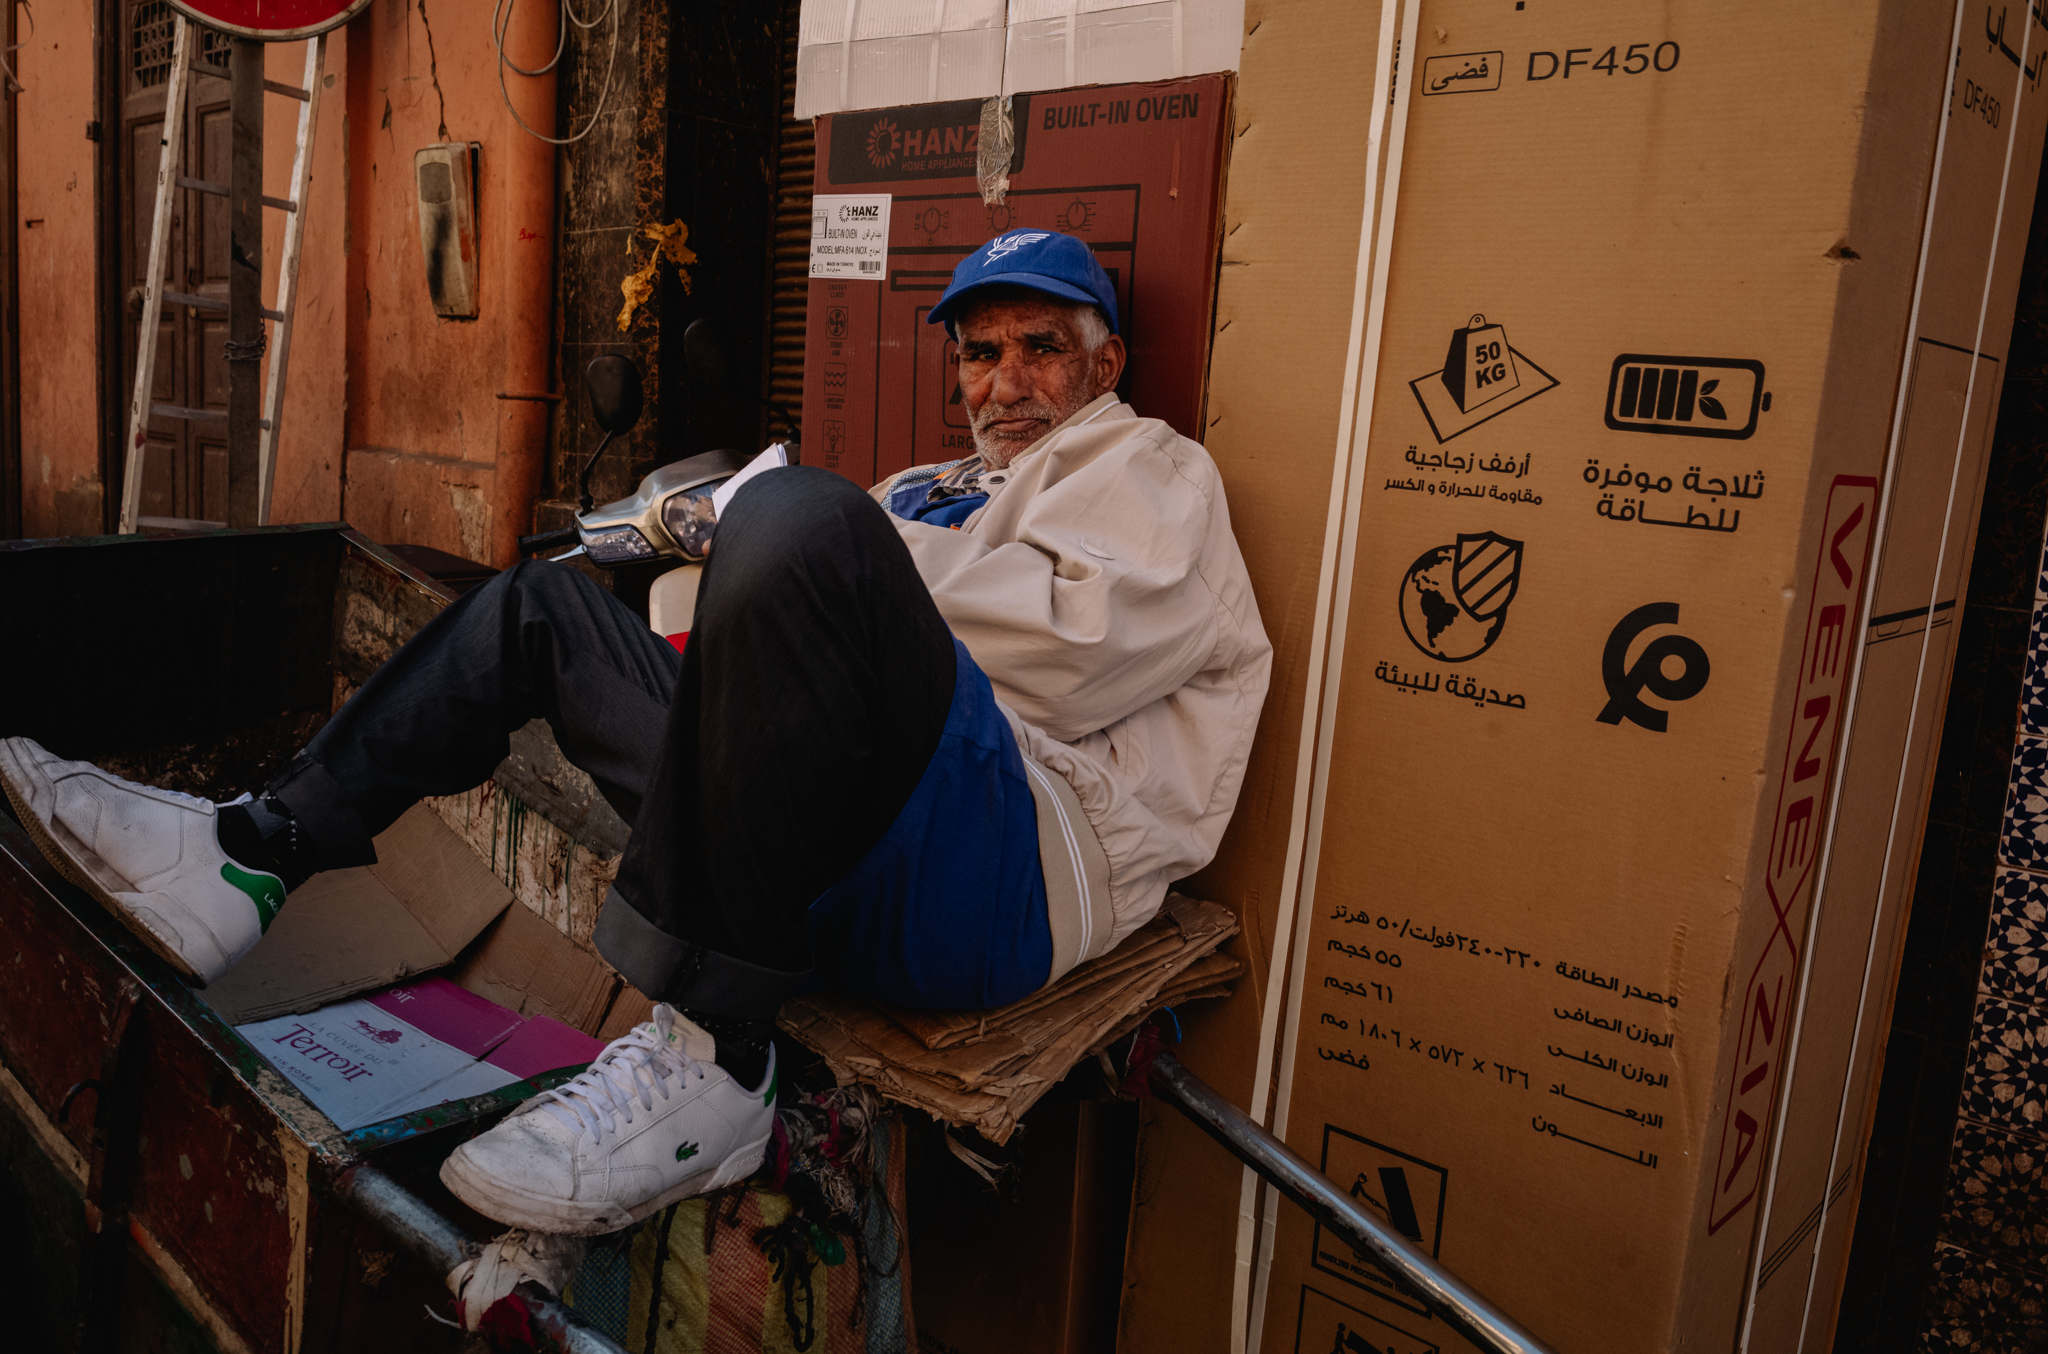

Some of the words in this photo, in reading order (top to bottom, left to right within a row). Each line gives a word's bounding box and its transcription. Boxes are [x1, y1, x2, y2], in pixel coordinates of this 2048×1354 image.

[1526, 40, 1681, 81] DF450
[1043, 100, 1131, 131] BUILT-IN
[1136, 92, 1200, 122] OVEN
[1963, 78, 2001, 129] DF450
[903, 124, 979, 158] HANZ
[901, 159, 926, 172] HOME
[927, 156, 978, 171] APPLIANCES
[852, 206, 879, 216] HANZ
[828, 283, 847, 291] ENERGY
[1475, 340, 1501, 365] 50
[1475, 362, 1506, 390] KG
[942, 433, 976, 450] LARG
[1404, 444, 1475, 475] زجاجية
[1478, 452, 1531, 478] أرفف
[1383, 477, 1425, 492] الكسر
[1582, 458, 1673, 494] موفرة
[1682, 465, 1765, 504] ثلاجة
[1427, 482, 1435, 496] و
[1438, 480, 1487, 498] للحرارة
[1488, 484, 1543, 506] مقاومة
[1374, 660, 1441, 695] للبيئة
[1444, 673, 1526, 710] صديقة
[1330, 904, 1370, 925] هرتز
[1327, 939, 1371, 960] كجم
[1375, 949, 1402, 968] ٥٥
[1324, 976, 1368, 998] كجم
[1555, 960, 1620, 992] الطاقة
[1370, 981, 1393, 1004] ٦١
[1621, 984, 1679, 1009] مصدر
[1320, 1012, 1348, 1030] مم
[308, 1021, 325, 1034] LA
[364, 1052, 384, 1065] DU
[1625, 1023, 1675, 1049] الوزن
[272, 1023, 374, 1083] Terroir
[1621, 1062, 1669, 1089] الوزن
[1318, 1249, 1350, 1271] HANDLING
